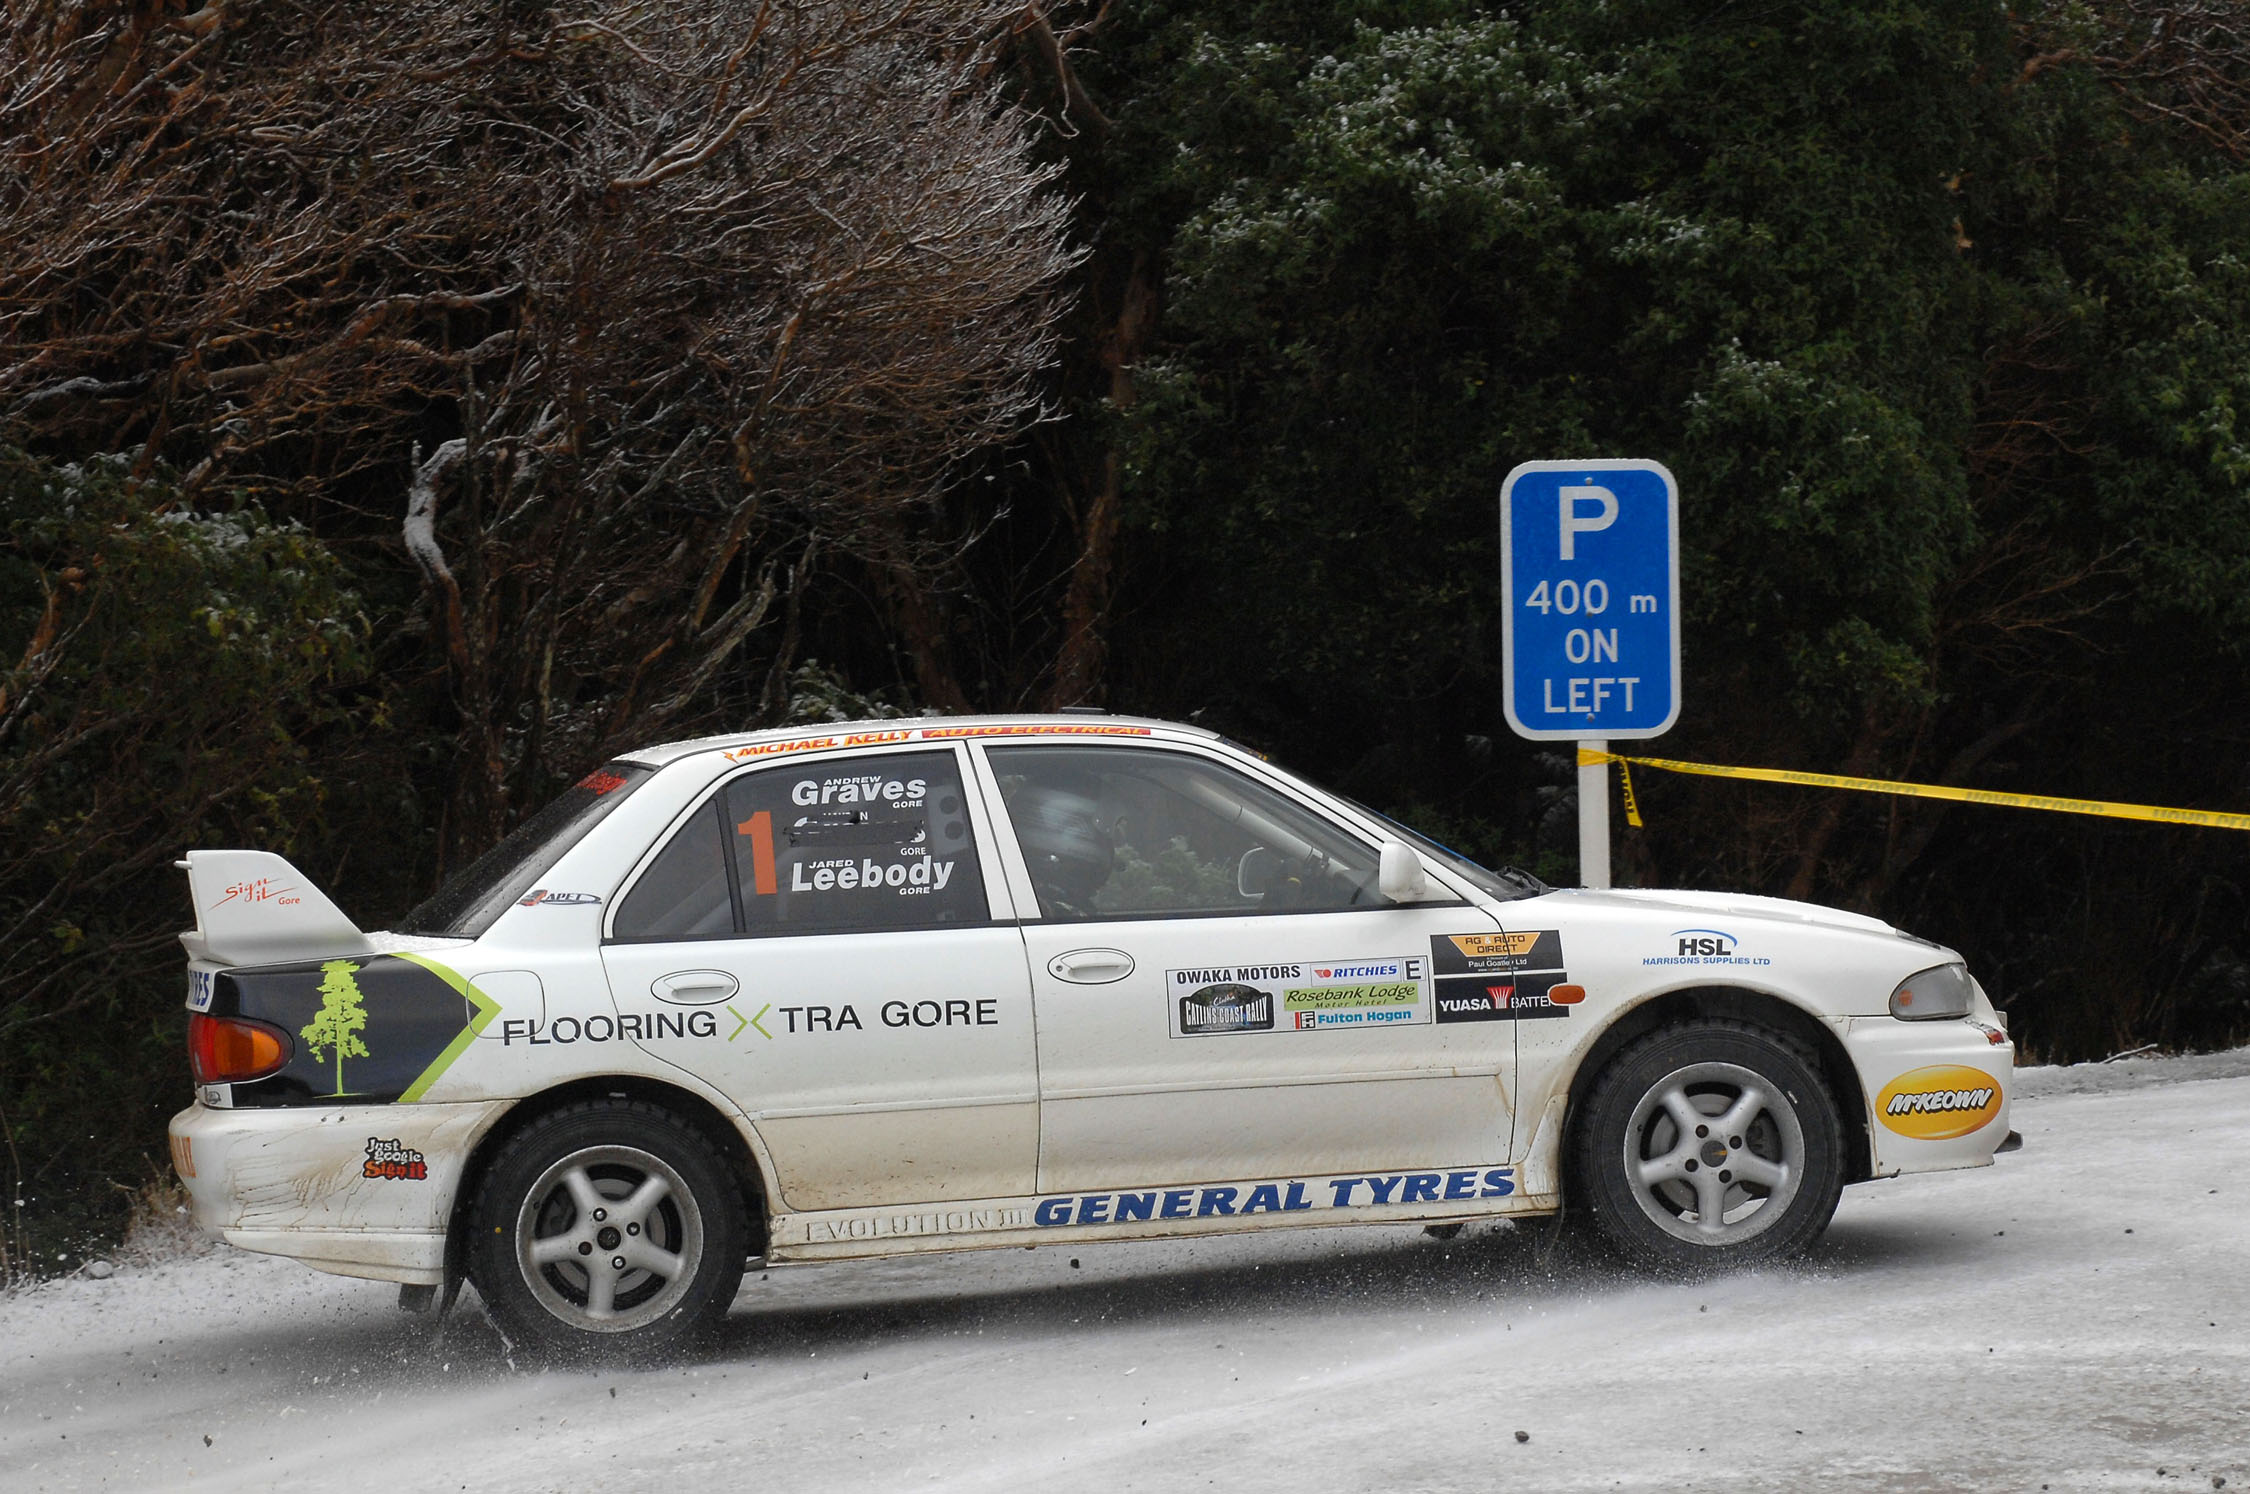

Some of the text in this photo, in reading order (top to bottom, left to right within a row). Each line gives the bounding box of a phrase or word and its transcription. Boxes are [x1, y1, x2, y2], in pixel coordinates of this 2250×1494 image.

[1559, 486, 1619, 560] P
[1525, 579, 1657, 615] 400 m
[1565, 628, 1618, 663] ON
[1544, 677, 1640, 713] LEFT
[738, 726, 1146, 757] MICHAEL KELLY AUTO ELECTRICAL
[824, 776, 881, 786] ANDREW
[792, 779, 927, 806] Graves
[892, 800, 923, 809] GORE
[737, 811, 777, 895] 1
[900, 847, 926, 856] GORE
[809, 859, 854, 869] JARED
[792, 856, 954, 891] Leebody
[899, 887, 930, 895] GORE
[278, 896, 300, 905] Gore
[1485, 936, 1491, 944] &
[1494, 935, 1525, 944] AUTO
[1679, 938, 1731, 956] HSL
[1477, 944, 1517, 953] DIRECT
[1405, 960, 1421, 980] E
[1468, 960, 1485, 968] Paul
[1642, 957, 1771, 966] HARRISONS SUPPLIES LTD
[1176, 965, 1301, 984] OWAKA MOTORS
[1333, 965, 1397, 978] RITCHIES
[1287, 985, 1415, 1002] Rosebank Lodge
[1185, 996, 1267, 1026] CATLINS COAST RALLY
[1314, 999, 1387, 1009] Motor Hotel
[1440, 998, 1491, 1012] YUASA
[503, 1010, 717, 1046] FLOORING
[880, 998, 999, 1027] GORE
[1318, 1010, 1411, 1024] Fulton Hogan
[367, 1138, 399, 1152] Just
[374, 1148, 421, 1165] google
[1033, 1167, 1516, 1227] GENERAL TYRES
[806, 1207, 1029, 1241] EVOLUTION III
